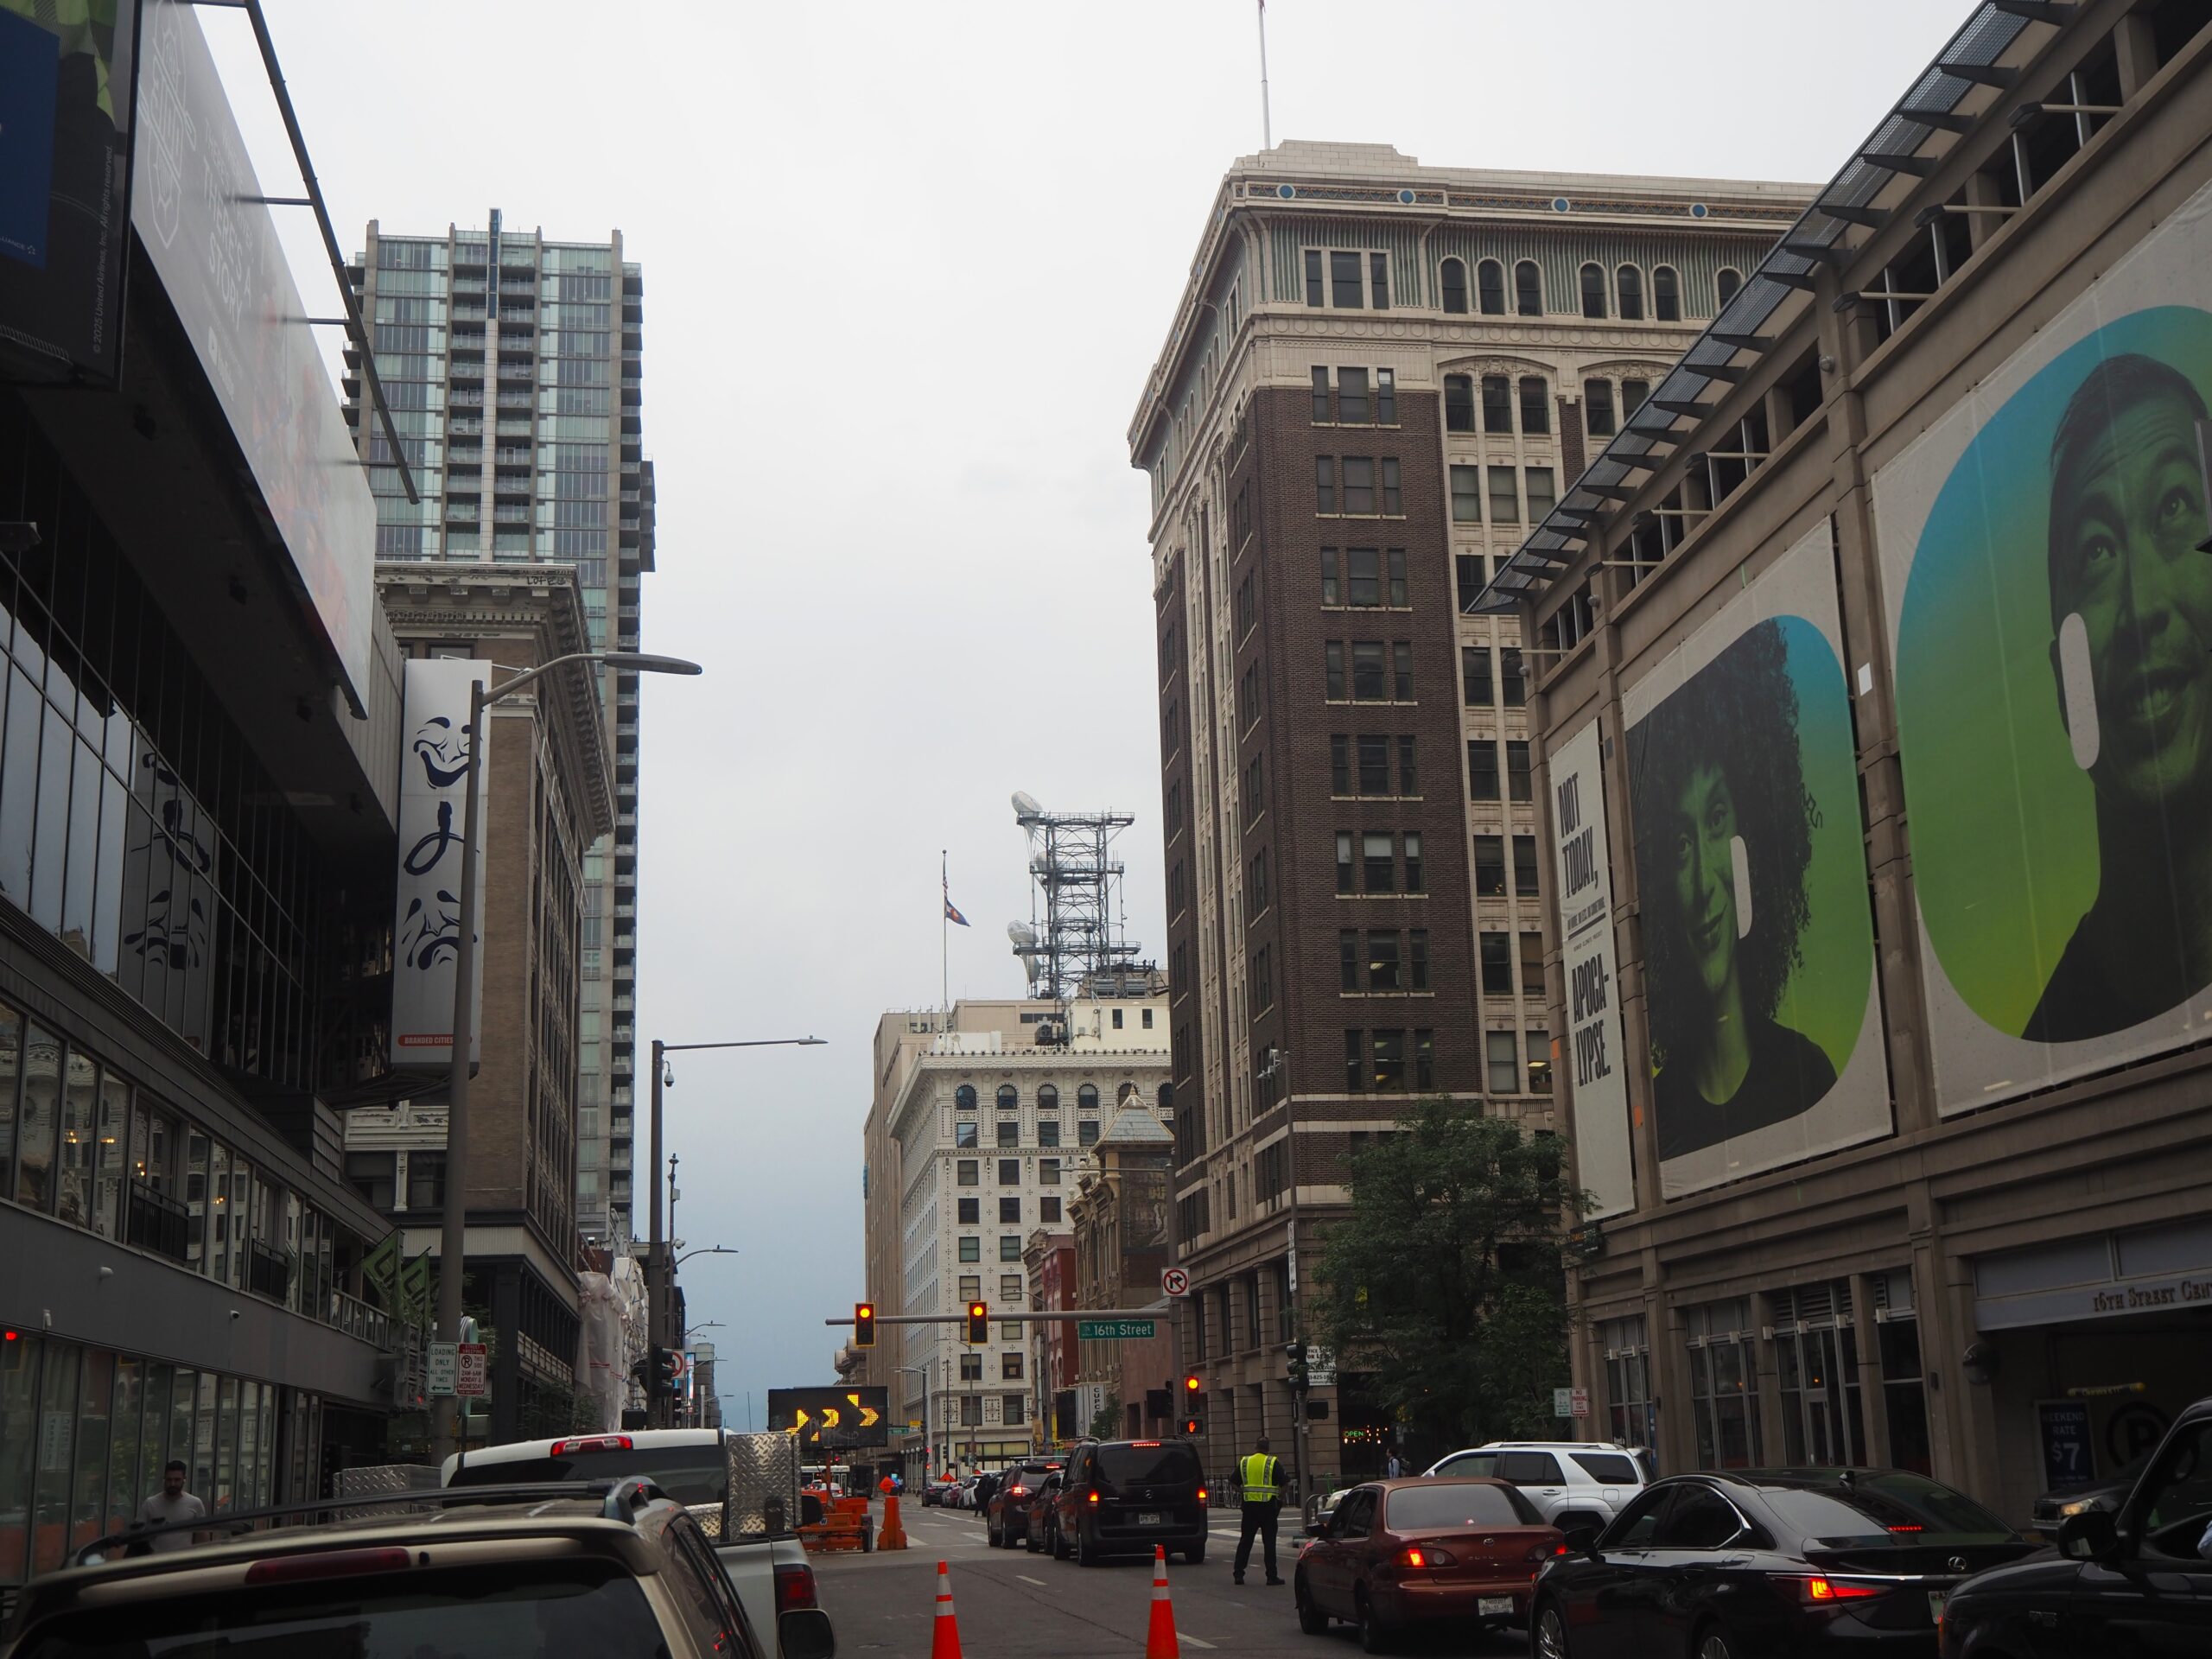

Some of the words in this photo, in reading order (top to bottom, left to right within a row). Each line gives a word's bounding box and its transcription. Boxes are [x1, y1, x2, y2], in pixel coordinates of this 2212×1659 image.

[103, 144, 113, 188] reserved.
[102, 188, 111, 213] rights
[99, 213, 110, 230] All
[201, 156, 245, 282] THERE'S
[244, 266, 251, 308] A
[99, 230, 107, 247] Inc.
[96, 249, 108, 284] Airlines,
[207, 232, 242, 331] STORY
[95, 284, 105, 317] United
[92, 317, 103, 345] 2025
[1558, 772, 1580, 838] NOT
[1562, 826, 1599, 899] TODAY,
[1572, 953, 1610, 1024] APOCA-
[1576, 1020, 1611, 1087] LYPSE.
[1094, 1324, 1116, 1336] 16th
[1119, 1324, 1152, 1336] Street
[2041, 1410, 2086, 1423] WEEKEND
[2052, 1425, 2077, 1435] RATE
[2051, 1440, 2081, 1471] $7
